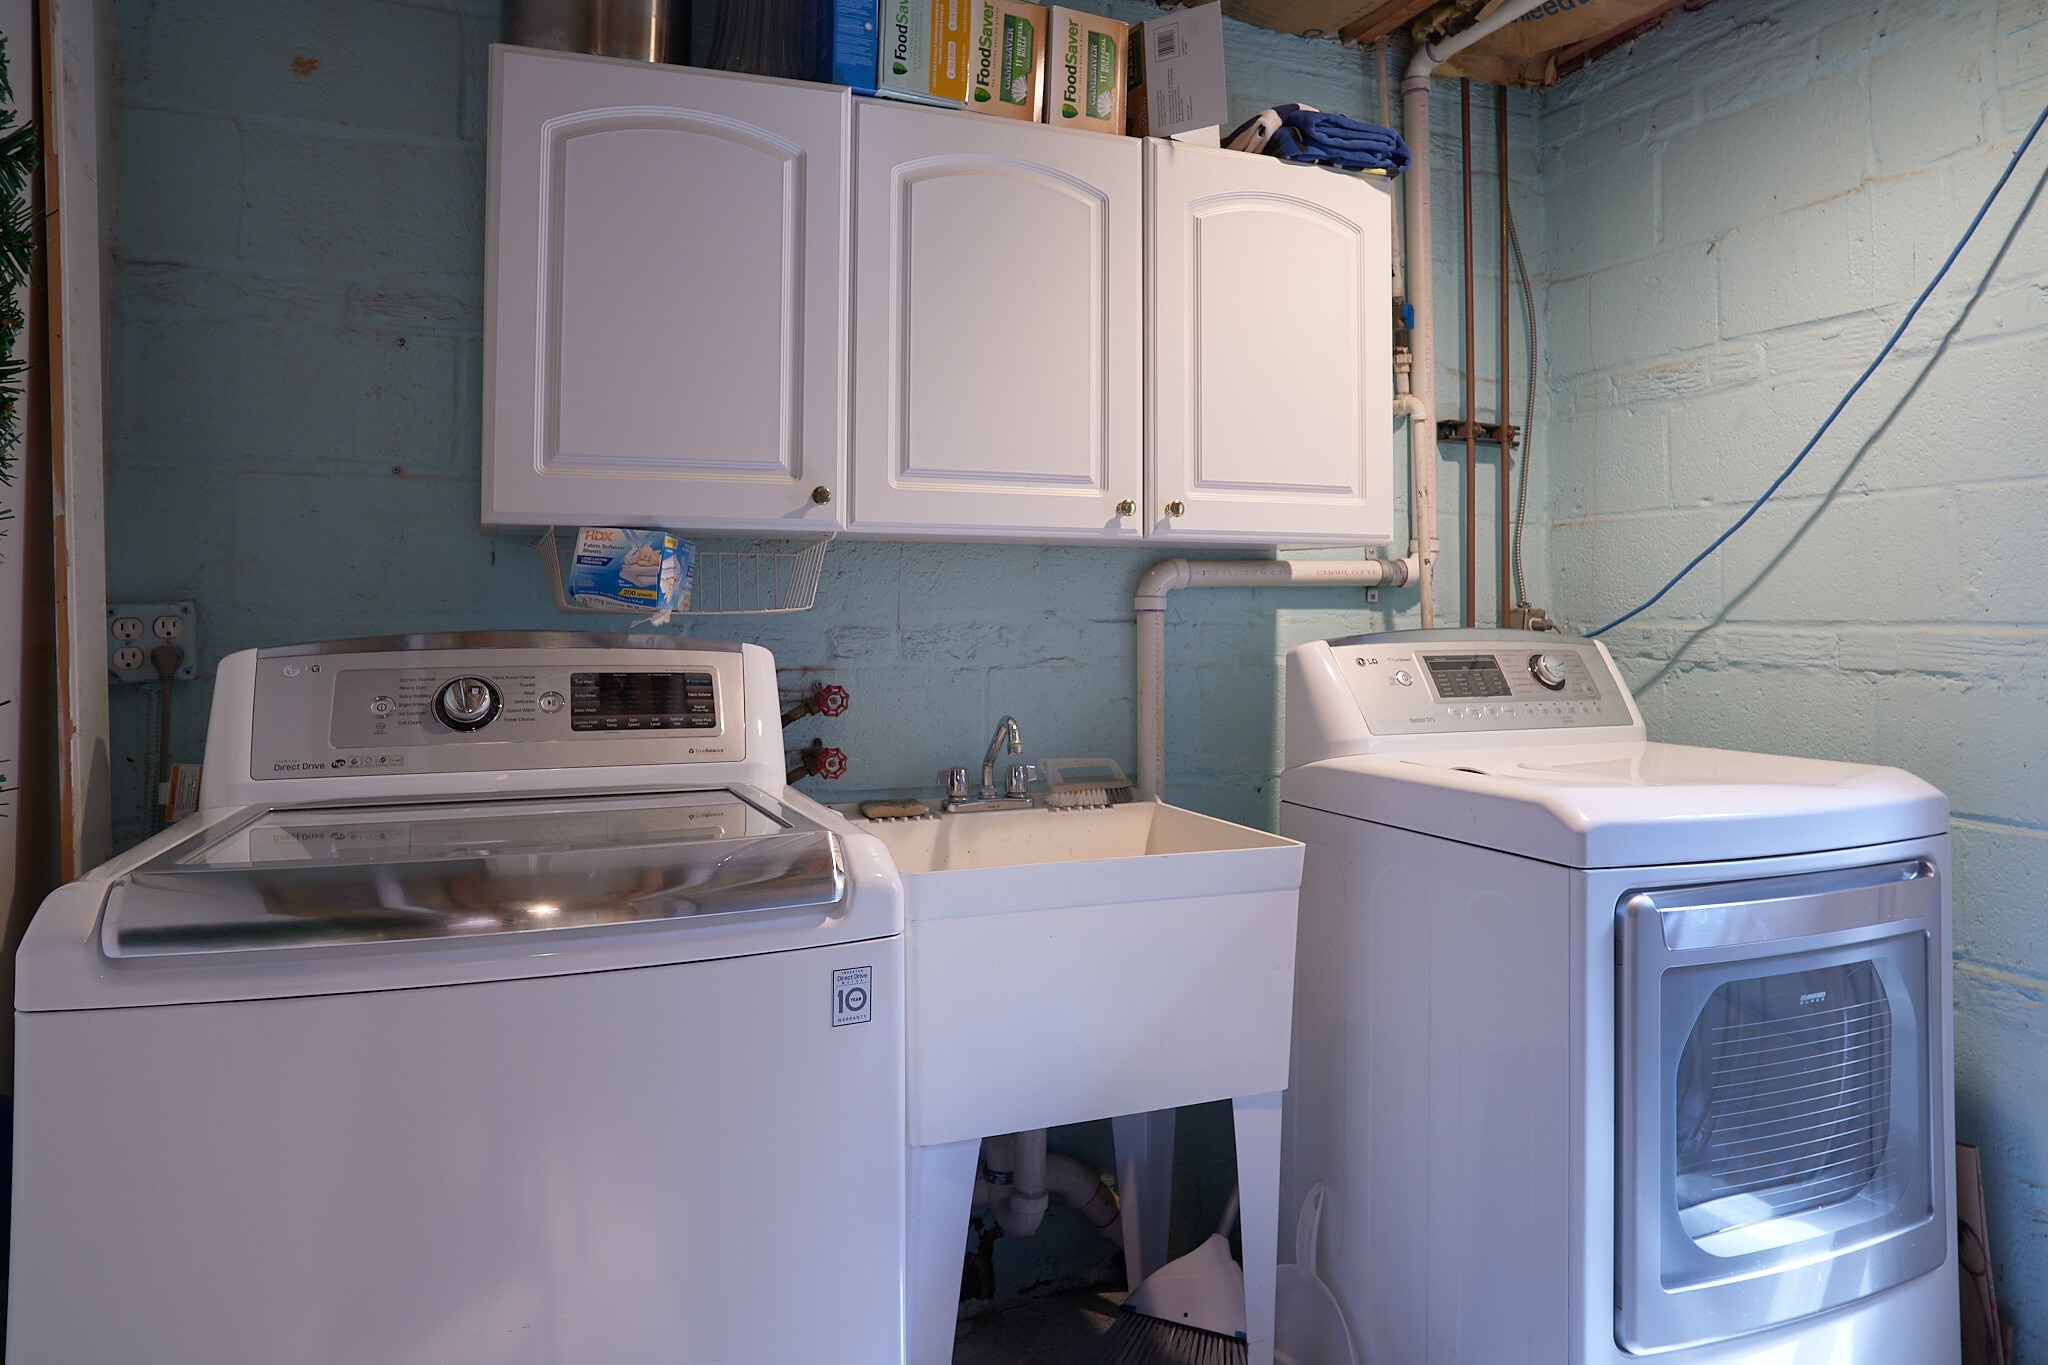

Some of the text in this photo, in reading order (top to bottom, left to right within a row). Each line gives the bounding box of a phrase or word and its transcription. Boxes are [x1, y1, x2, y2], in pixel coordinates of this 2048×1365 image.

[976, 2, 994, 86] FoodSaver
[1003, 27, 1014, 90] GAMESAVER
[1064, 19, 1078, 102] FoodSaver
[586, 530, 613, 542] HDX
[274, 762, 325, 771] Direct Drive
[837, 987, 867, 1013] 10
